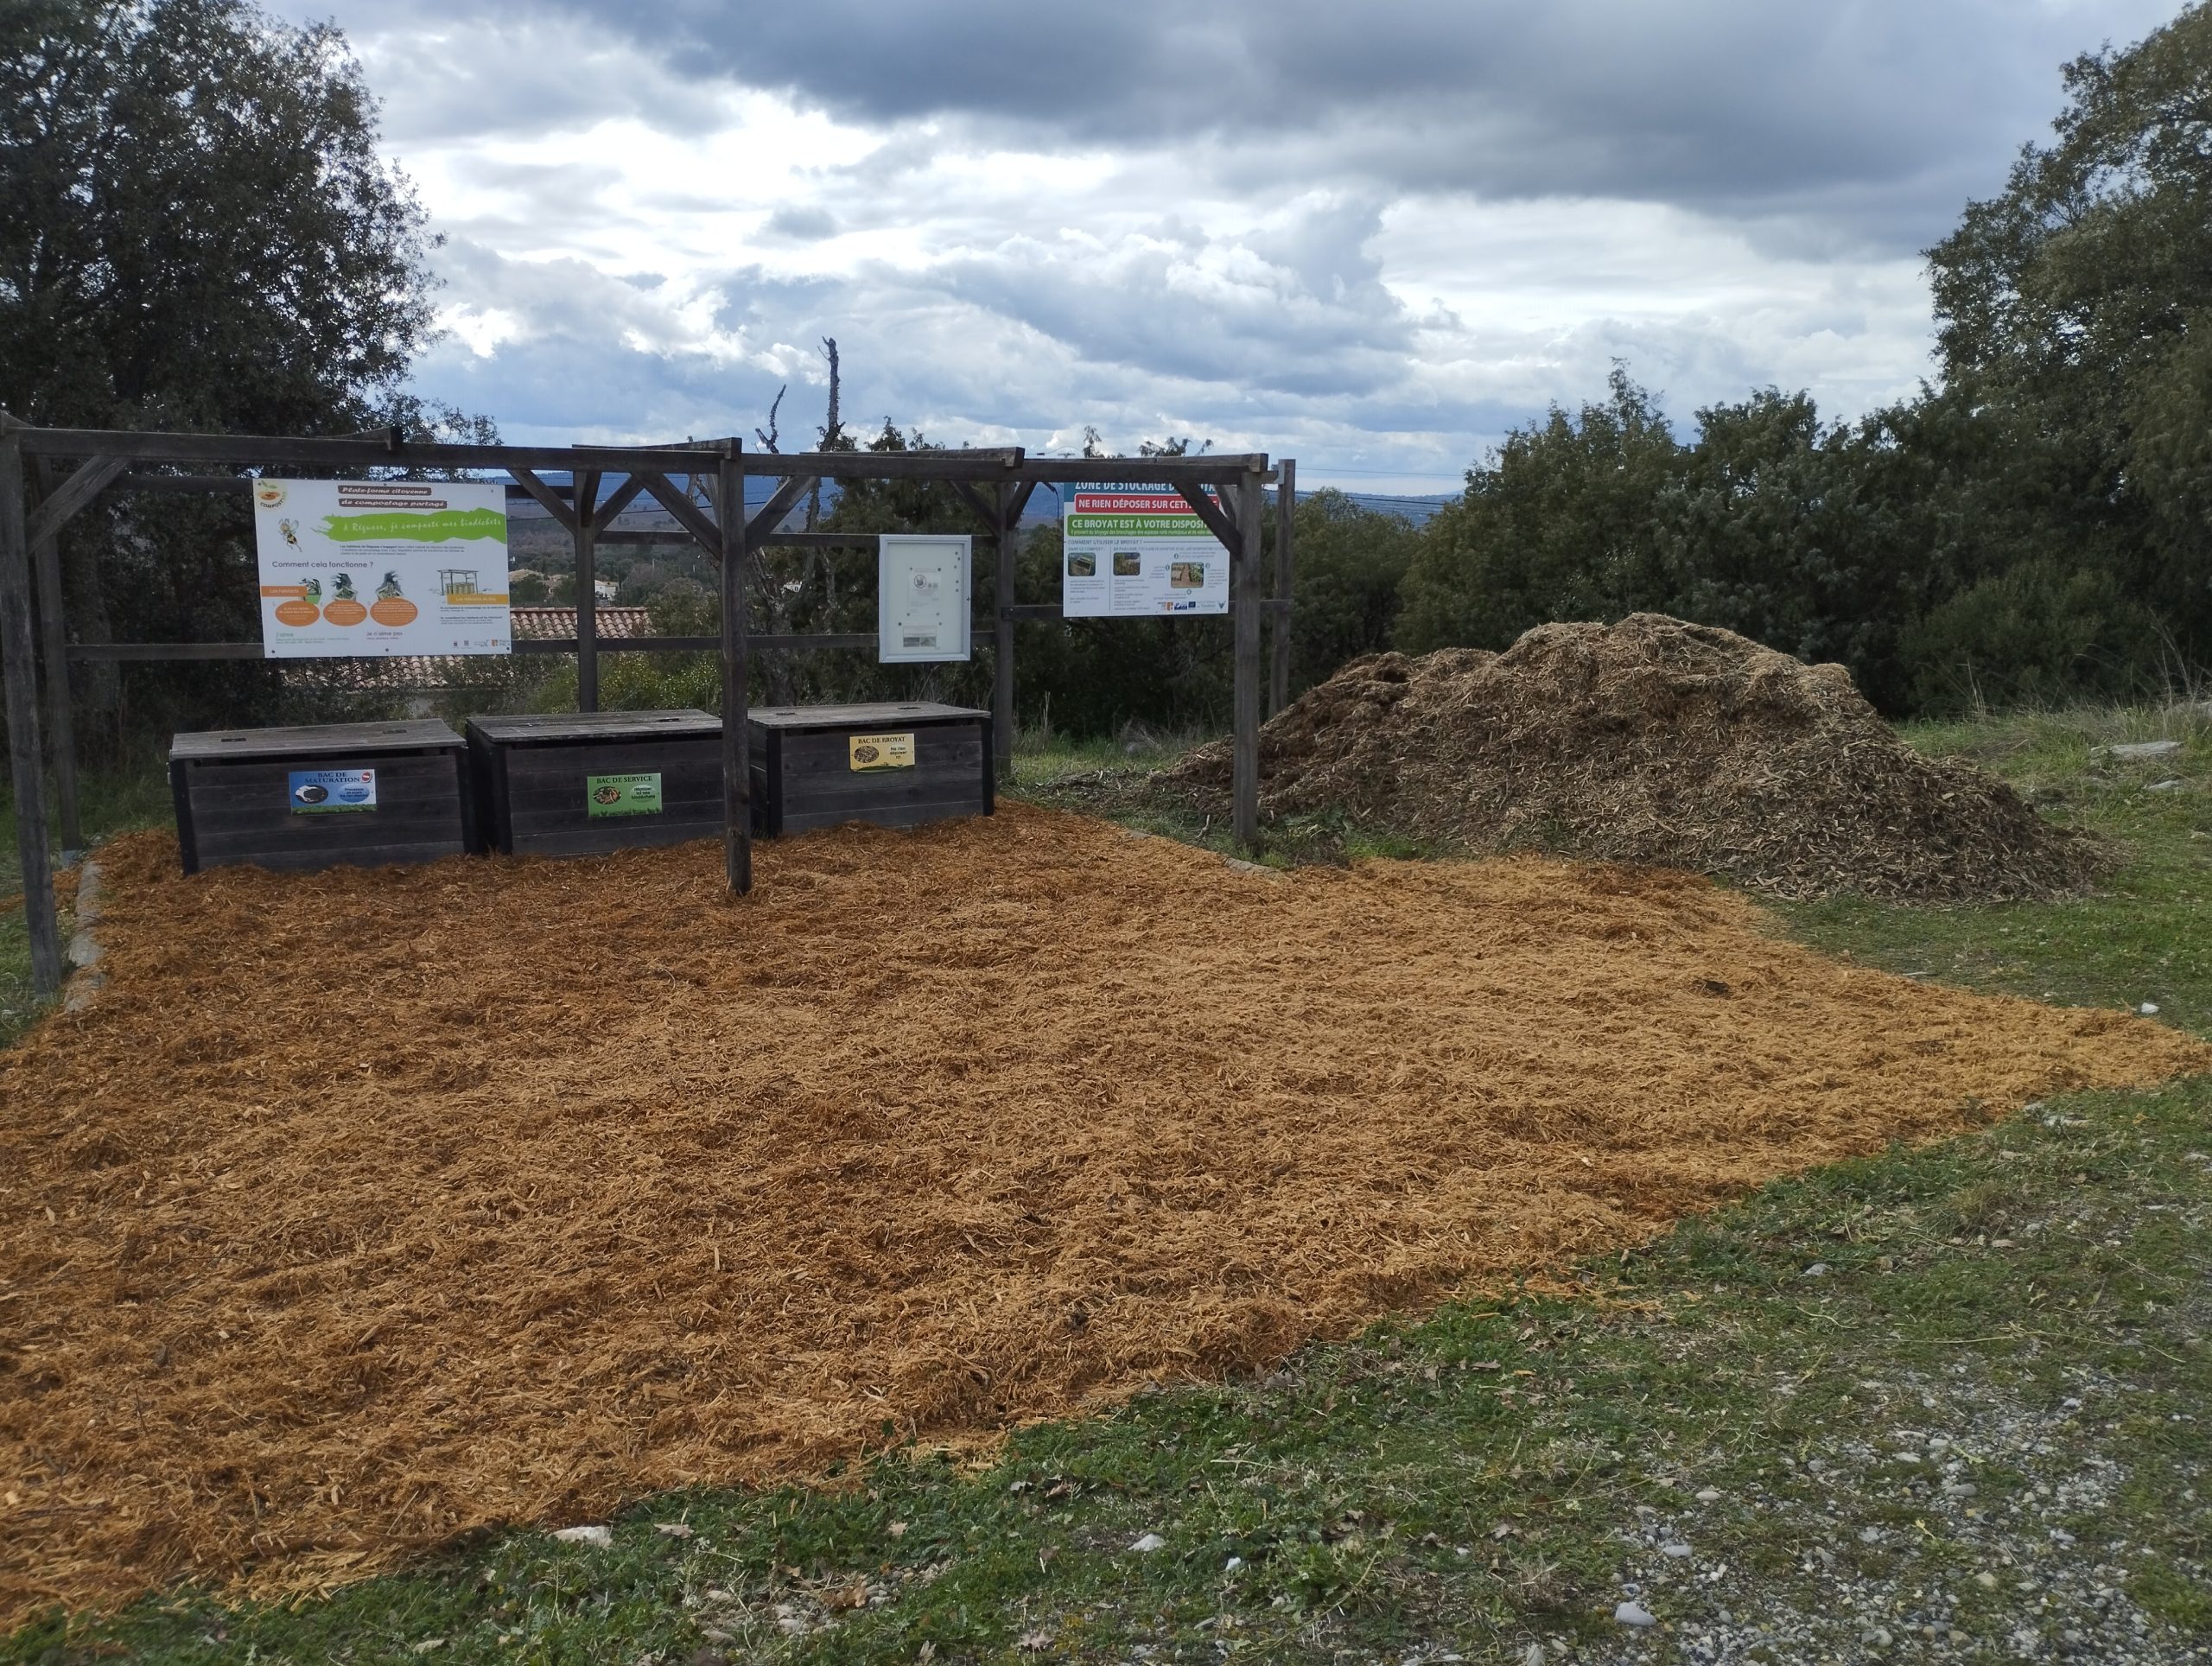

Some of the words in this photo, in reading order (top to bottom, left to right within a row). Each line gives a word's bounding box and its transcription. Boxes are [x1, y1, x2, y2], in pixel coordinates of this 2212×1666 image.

[1078, 499, 1090, 508] NE
[1092, 499, 1110, 508] RIEN
[1113, 498, 1150, 509] DÉPOSER
[1152, 499, 1167, 509] SUR
[1169, 500, 1192, 509] CETT
[1071, 519, 1083, 528] CE
[1084, 519, 1118, 528] BROYAT
[1120, 519, 1135, 528] EST
[1135, 518, 1142, 528] À
[1143, 519, 1171, 528] VOTRE
